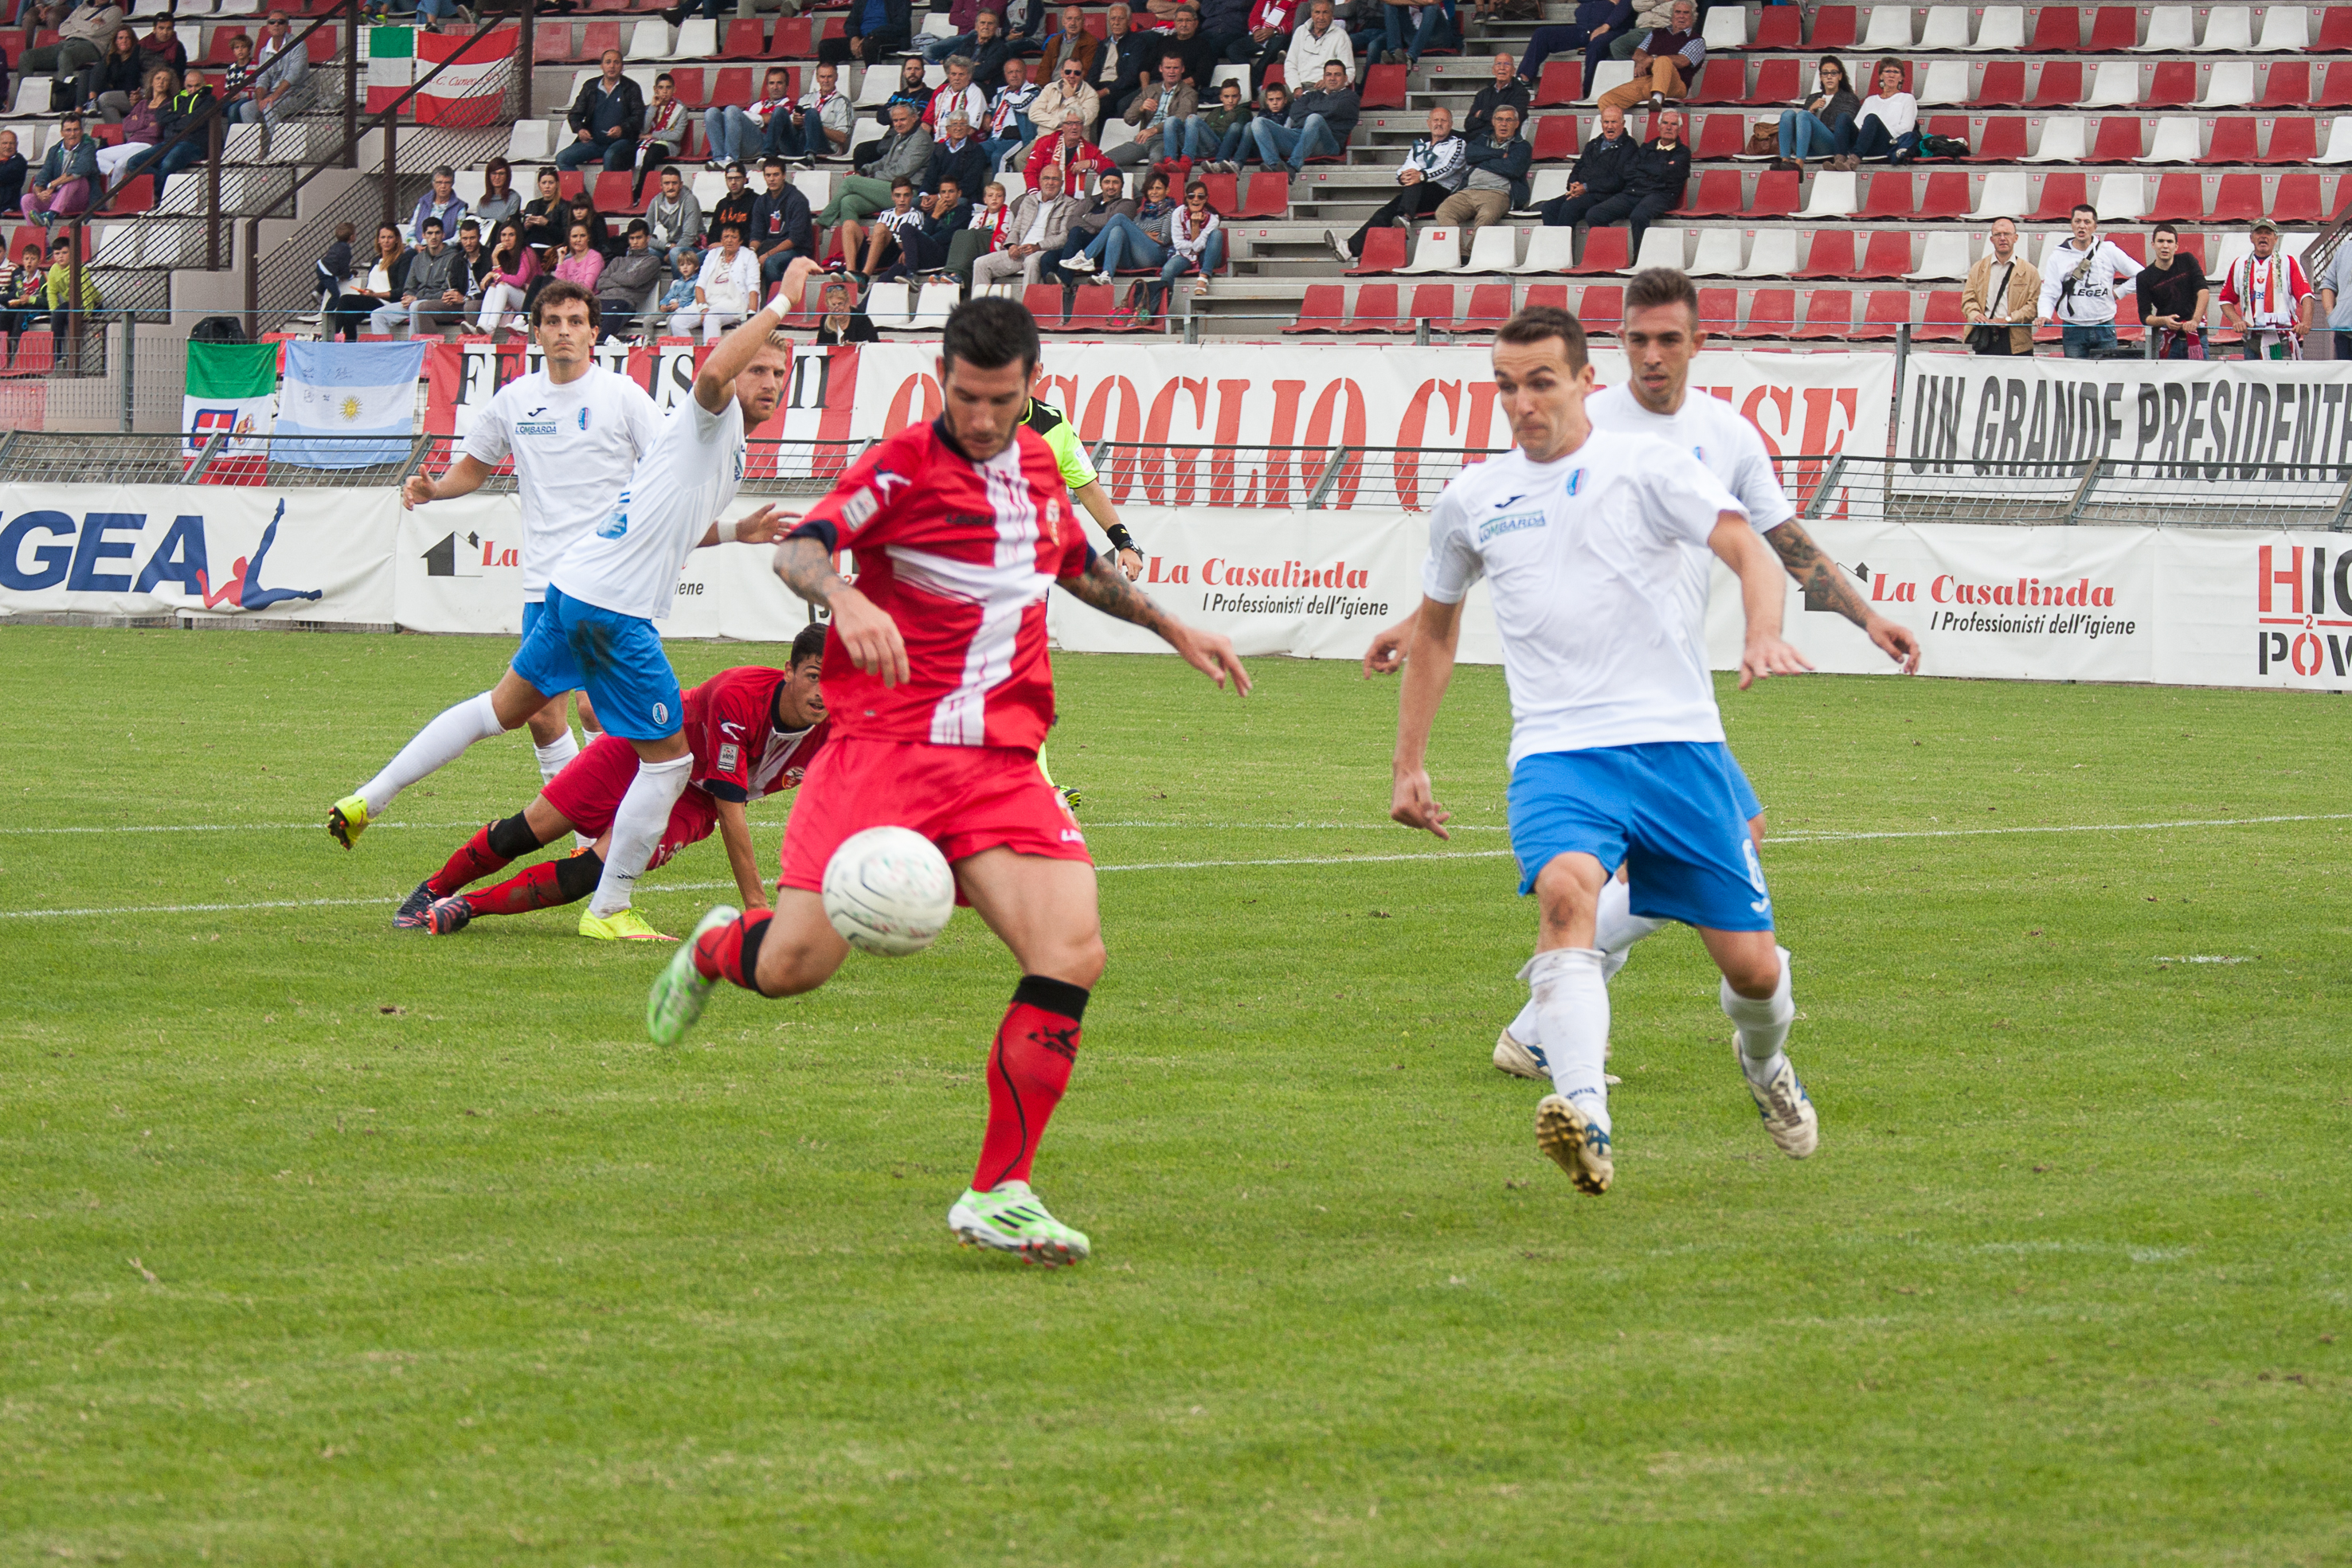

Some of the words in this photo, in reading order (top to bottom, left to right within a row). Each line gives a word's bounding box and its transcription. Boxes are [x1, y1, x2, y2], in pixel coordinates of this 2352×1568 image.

[2071, 287, 2108, 298] LEGEA
[451, 353, 836, 409] FEISMI
[515, 425, 557, 434] LOMBARDA
[875, 371, 1367, 510] OOGLIO
[1911, 374, 1966, 474] UN
[1971, 375, 2125, 478] GRANDE
[1478, 515, 1546, 544] LOMBARDA
[0, 510, 211, 595] GEA
[481, 540, 520, 567] La
[1147, 556, 1191, 585] La
[1202, 557, 1370, 589] Casalinda
[1203, 592, 1209, 612] I
[1211, 592, 1305, 615] Professionisti
[1870, 573, 1918, 603] La
[1931, 574, 2116, 608] Casalinda
[1930, 611, 1939, 631] I
[1942, 611, 2045, 635] Professionisti
[2305, 614, 2314, 630] 2
